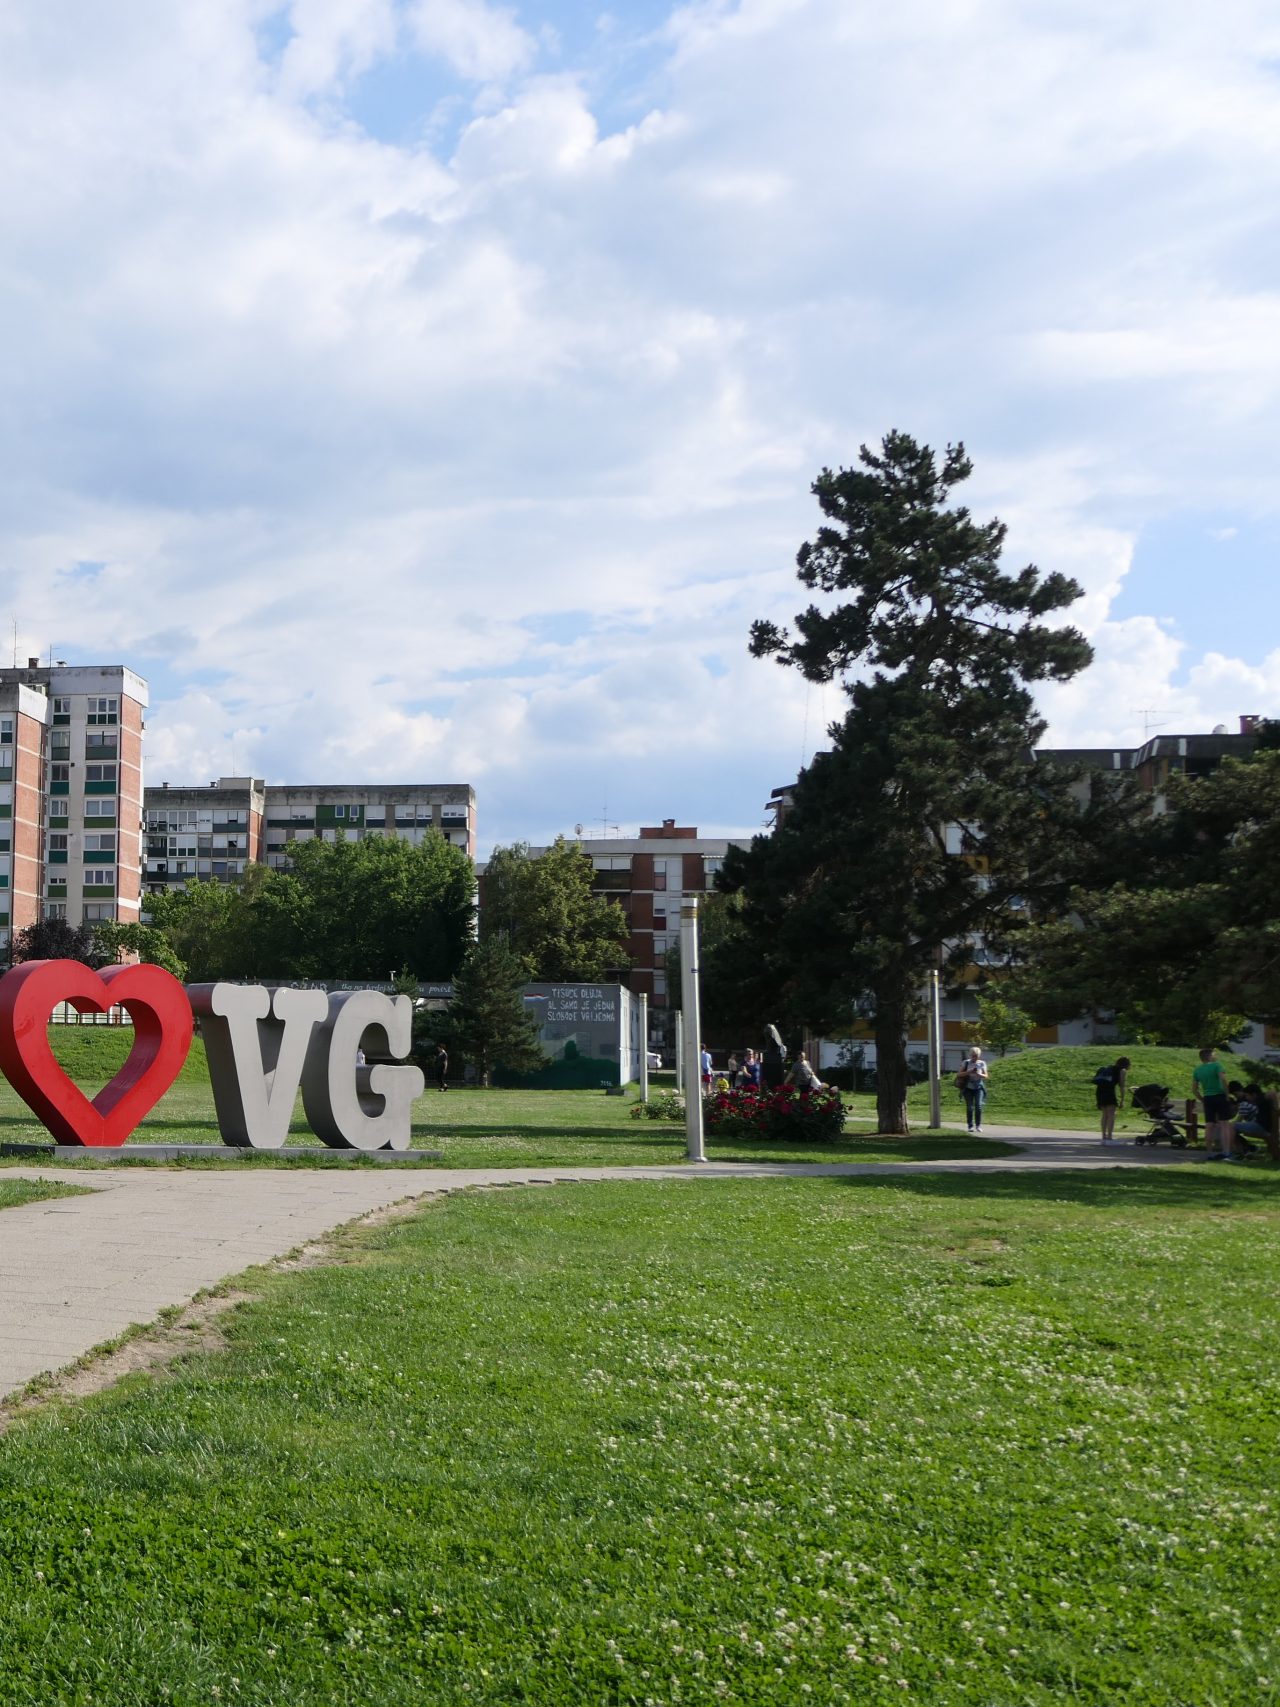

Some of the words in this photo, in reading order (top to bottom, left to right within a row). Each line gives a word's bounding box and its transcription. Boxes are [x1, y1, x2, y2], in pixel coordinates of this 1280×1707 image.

[560, 1000, 578, 1010] SAMO
[581, 1000, 590, 1010] JE
[593, 1000, 615, 1011] JEDNA
[210, 982, 425, 1151] VG
